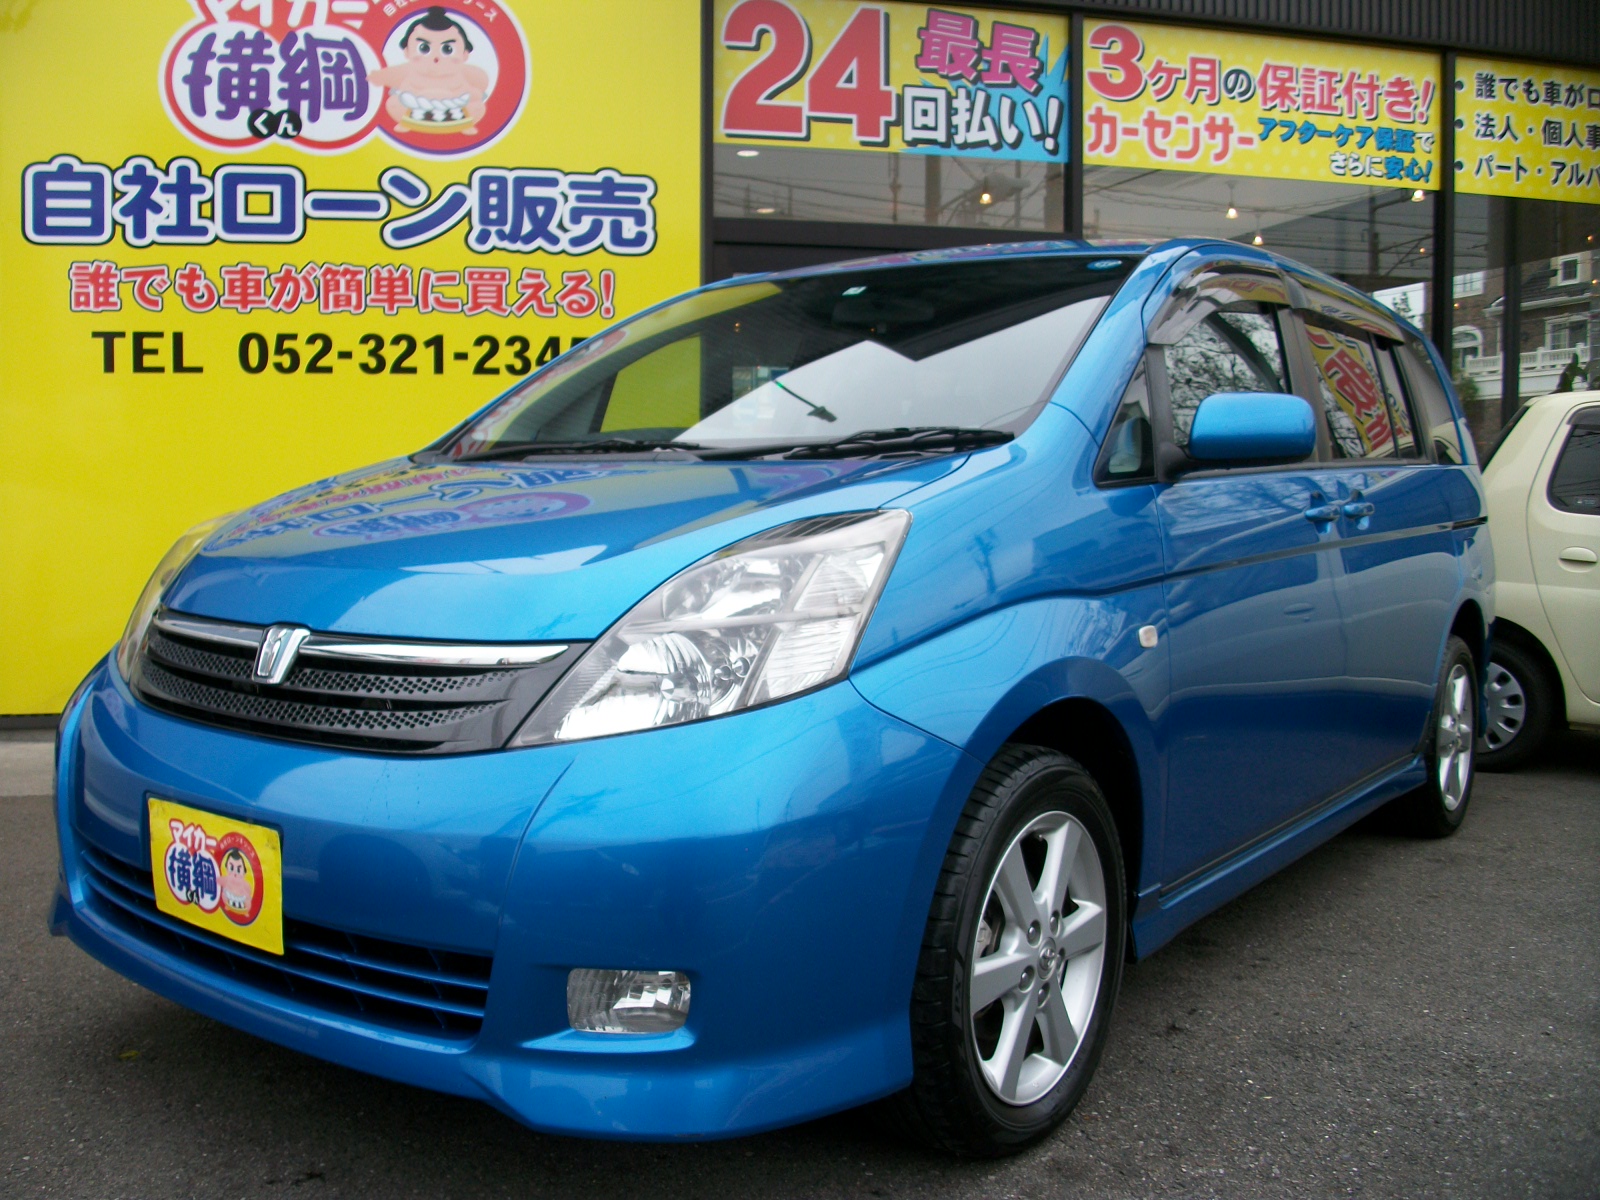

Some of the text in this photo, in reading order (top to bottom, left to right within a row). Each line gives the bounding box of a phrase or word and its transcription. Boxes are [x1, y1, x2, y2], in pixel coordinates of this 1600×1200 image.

[182, 30, 370, 123] 横綱
[722, 0, 897, 143] 24
[914, 8, 1043, 95] 最長
[251, 111, 301, 139] くん
[902, 86, 1063, 154] 回払い!
[1085, 105, 1257, 163] カーセンサー
[1257, 117, 1435, 154] アフターケア保証で
[1330, 151, 1433, 183] さらに安心!
[25, 158, 653, 252] 自社ローン販売
[70, 262, 616, 318] 誰でも車が簡単に買える!
[92, 332, 204, 374] TEL
[169, 820, 217, 851] マイカー
